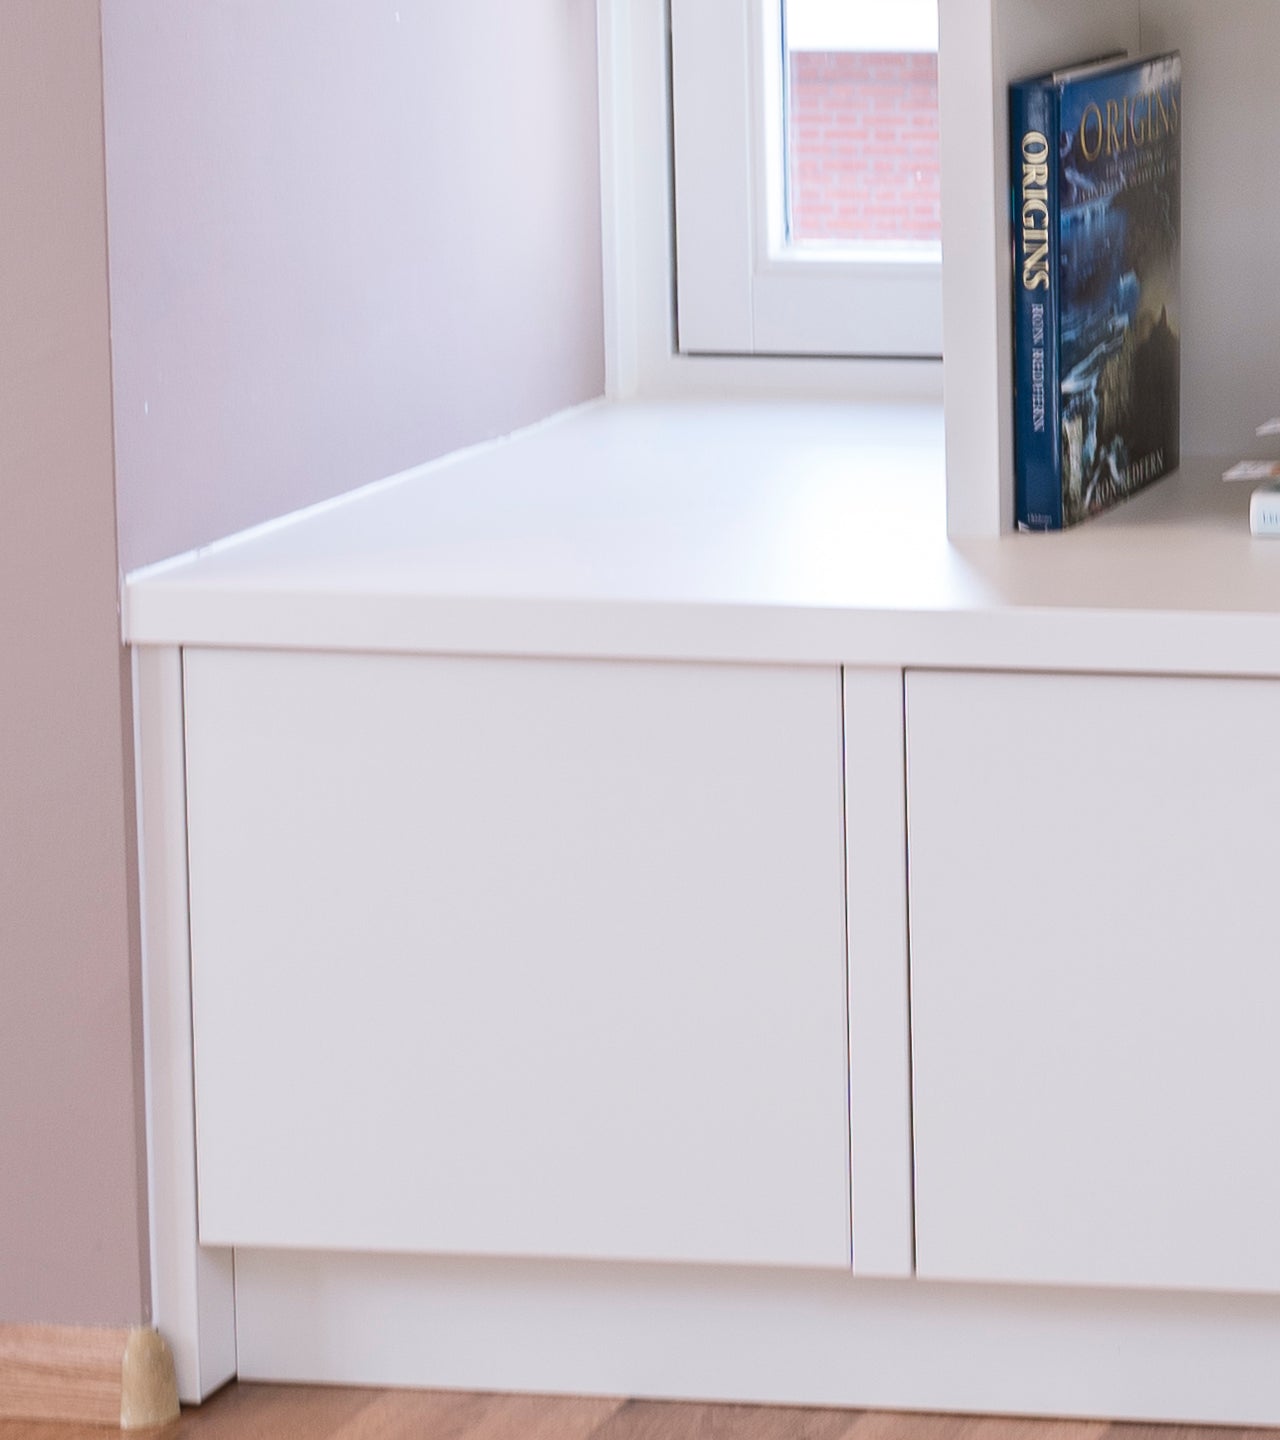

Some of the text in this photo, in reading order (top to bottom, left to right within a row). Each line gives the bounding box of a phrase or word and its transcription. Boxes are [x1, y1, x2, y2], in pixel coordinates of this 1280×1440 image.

[1080, 92, 1179, 161] ORIGINS
[1021, 130, 1050, 291] ORIGINS
[1032, 303, 1045, 432] RON REDFERN
